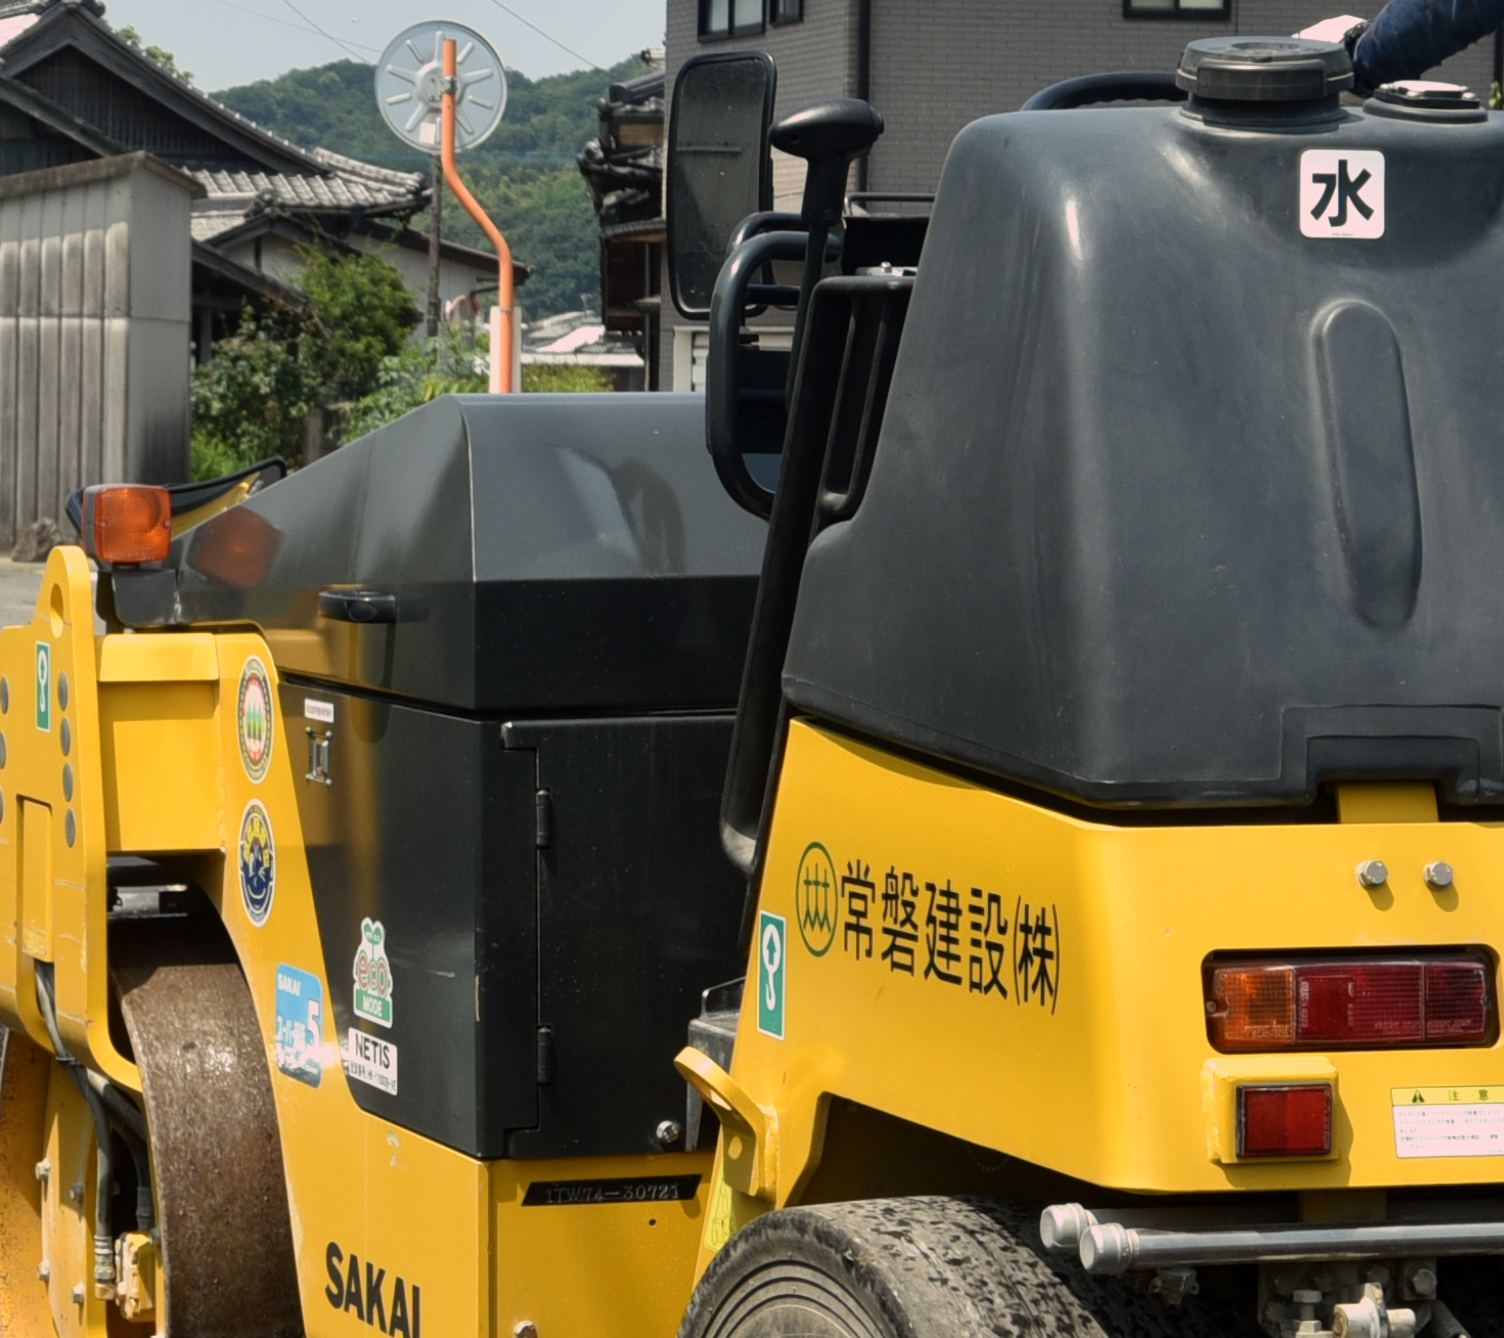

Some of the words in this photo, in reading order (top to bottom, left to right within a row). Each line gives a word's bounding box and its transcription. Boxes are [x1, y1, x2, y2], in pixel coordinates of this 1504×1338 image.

[1310, 159, 1374, 227] 水
[841, 858, 1060, 1015] 常磐建設(株)
[362, 995, 383, 1018] MODE
[355, 1032, 390, 1069] NETIS
[1448, 1089, 1489, 1101] 注意
